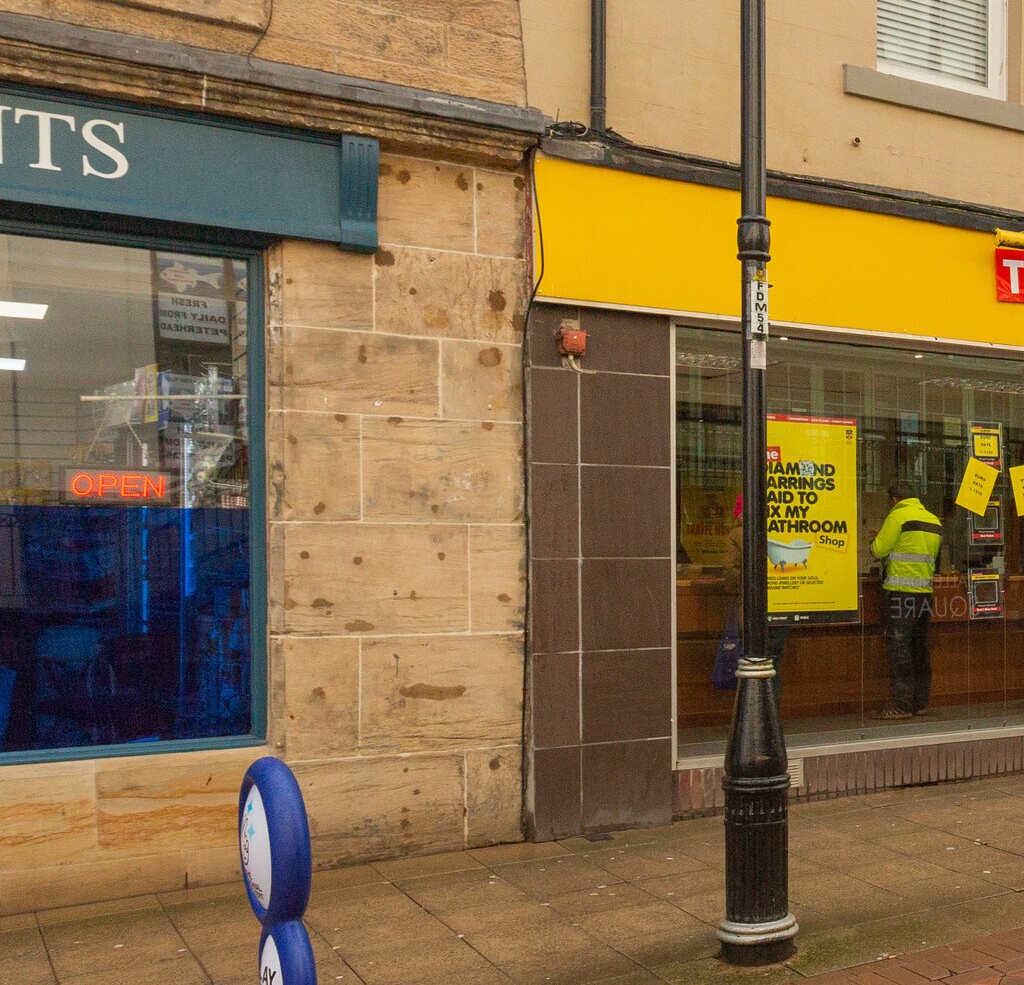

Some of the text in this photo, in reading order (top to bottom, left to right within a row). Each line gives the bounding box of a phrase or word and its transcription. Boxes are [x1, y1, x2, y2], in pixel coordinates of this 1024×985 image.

[767, 461, 836, 476] IAMND
[70, 472, 165, 498] OPEN
[767, 476, 835, 491] ARRINGS
[767, 490, 818, 505] AID TO
[767, 505, 810, 518] IX MY
[767, 519, 847, 534] ATHROOM
[819, 535, 845, 549] Shop
[259, 966, 277, 985] AY
